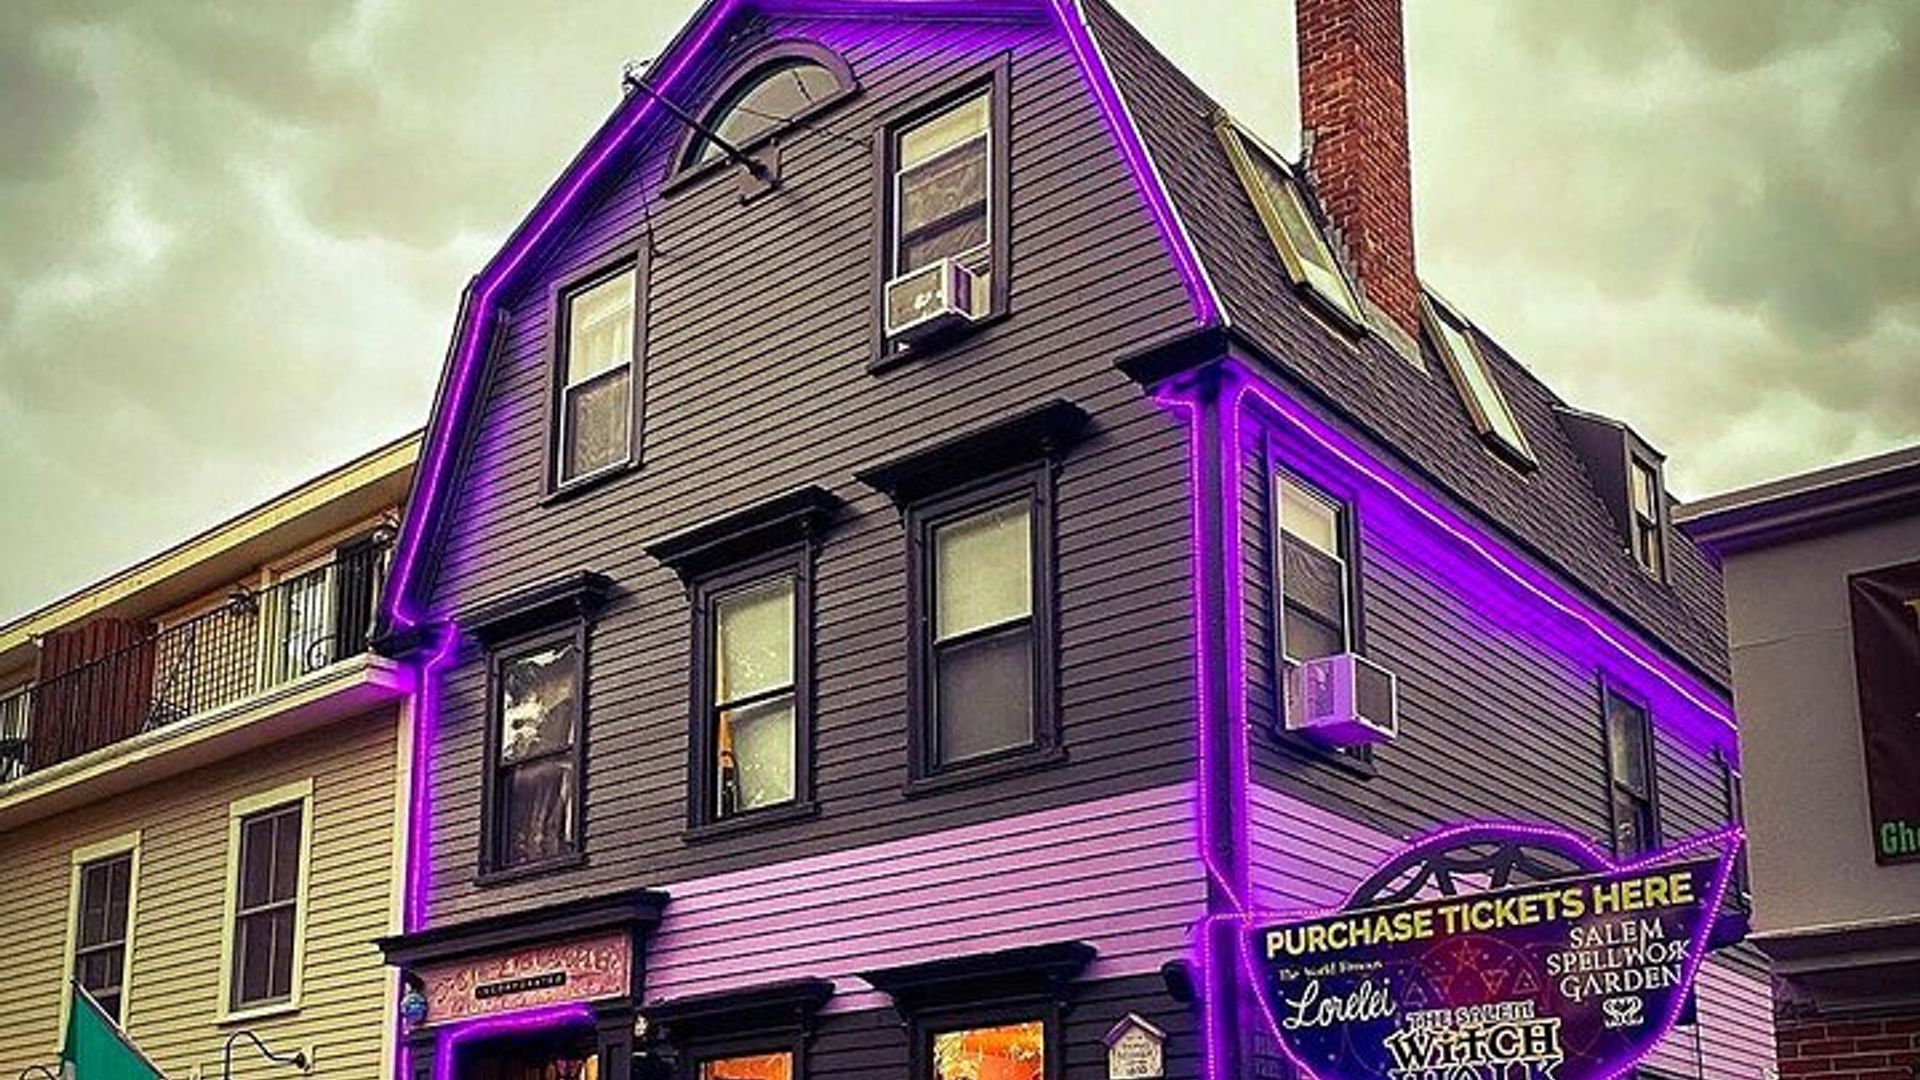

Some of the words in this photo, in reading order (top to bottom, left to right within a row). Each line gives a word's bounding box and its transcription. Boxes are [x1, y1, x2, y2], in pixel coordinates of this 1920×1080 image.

[1880, 821, 1920, 854] Gh
[1266, 908, 1433, 959] PURCHASE
[1438, 888, 1585, 933] TICKETS
[1593, 872, 1695, 914] HERE
[1570, 917, 1665, 950] SALEM
[1546, 938, 1692, 976] SPELLWORK
[1560, 964, 1682, 1002] GARDEN
[1282, 978, 1396, 1029] Lorelei
[1406, 1009, 1452, 1030] THE
[1455, 1001, 1534, 1026] SALEM
